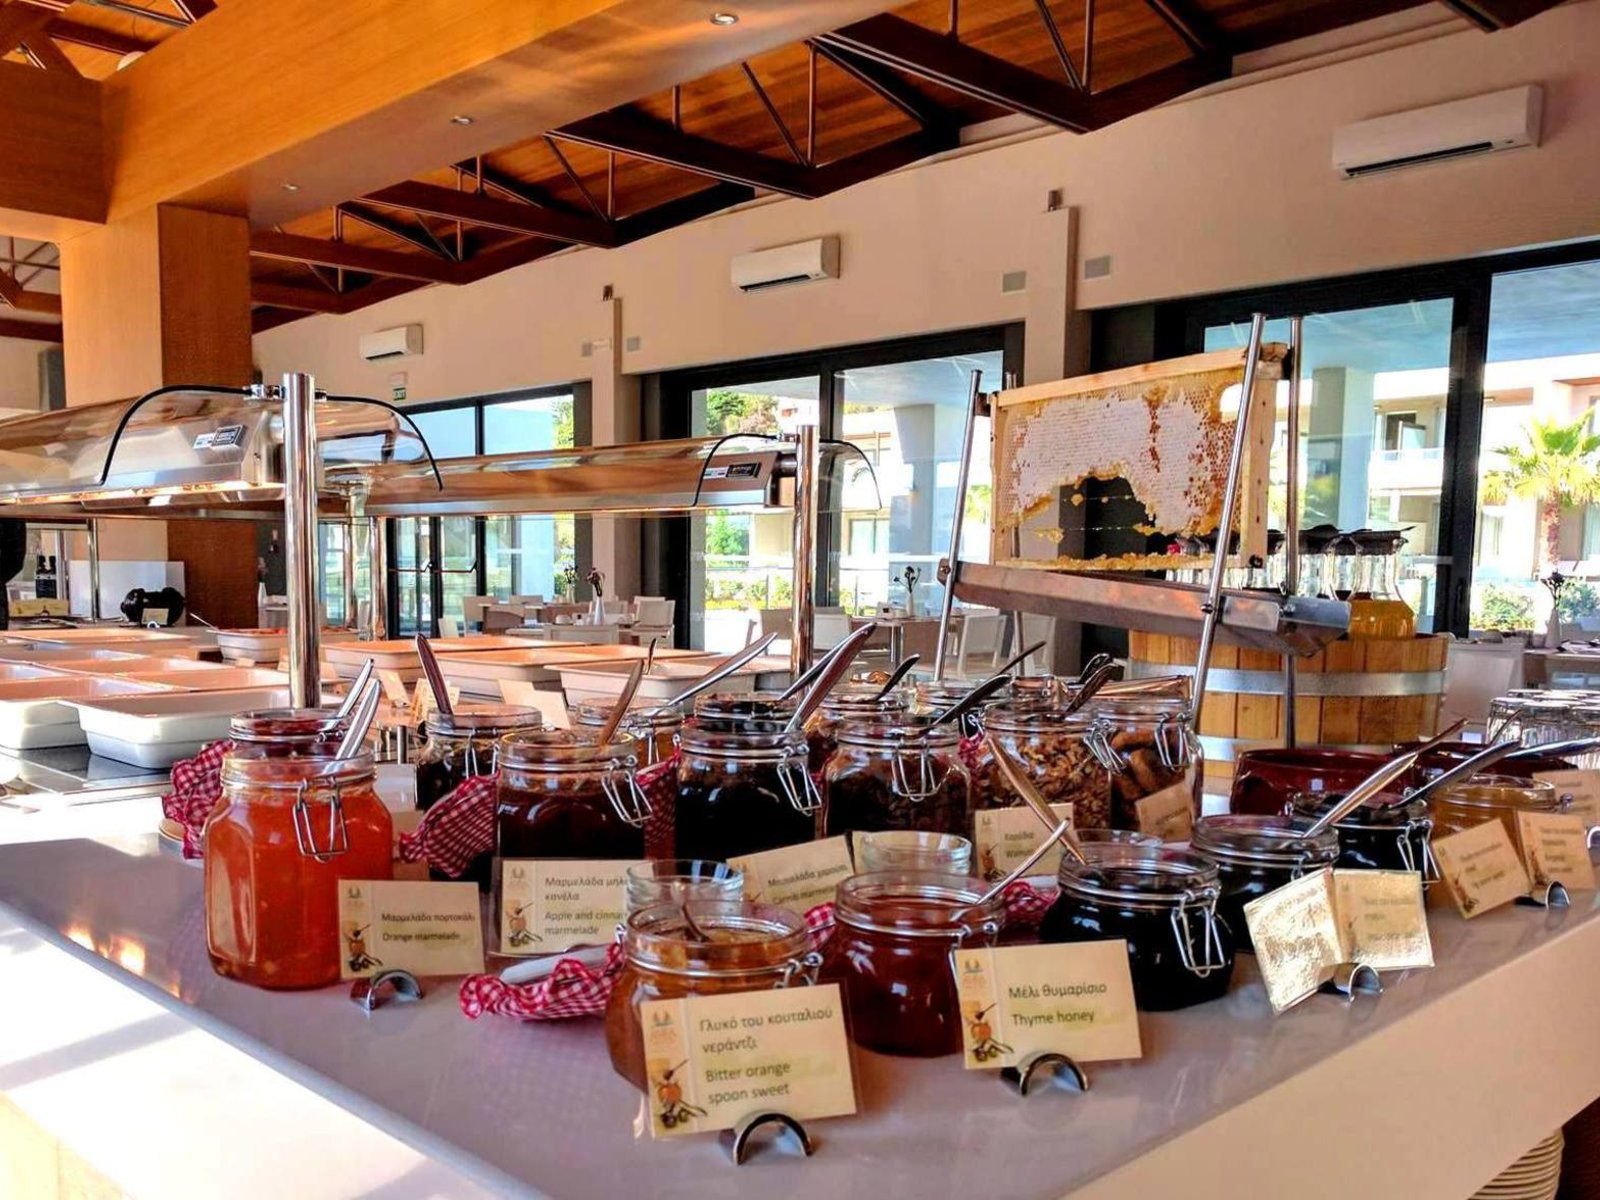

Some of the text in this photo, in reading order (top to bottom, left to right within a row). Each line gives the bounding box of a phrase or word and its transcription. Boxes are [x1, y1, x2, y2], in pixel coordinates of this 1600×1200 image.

[544, 911, 573, 921] Apple
[575, 910, 593, 920] and
[382, 932, 413, 943] Orange
[1008, 982, 1108, 999] Μέλι θυμαρίσιο
[699, 1007, 833, 1033] Γλυκό του κουταλιού
[1012, 1010, 1095, 1028] Thyme honey
[702, 1036, 757, 1054] νεράντζι
[706, 1061, 791, 1083] Bitter orange
[708, 1082, 790, 1106] spoon sweet
